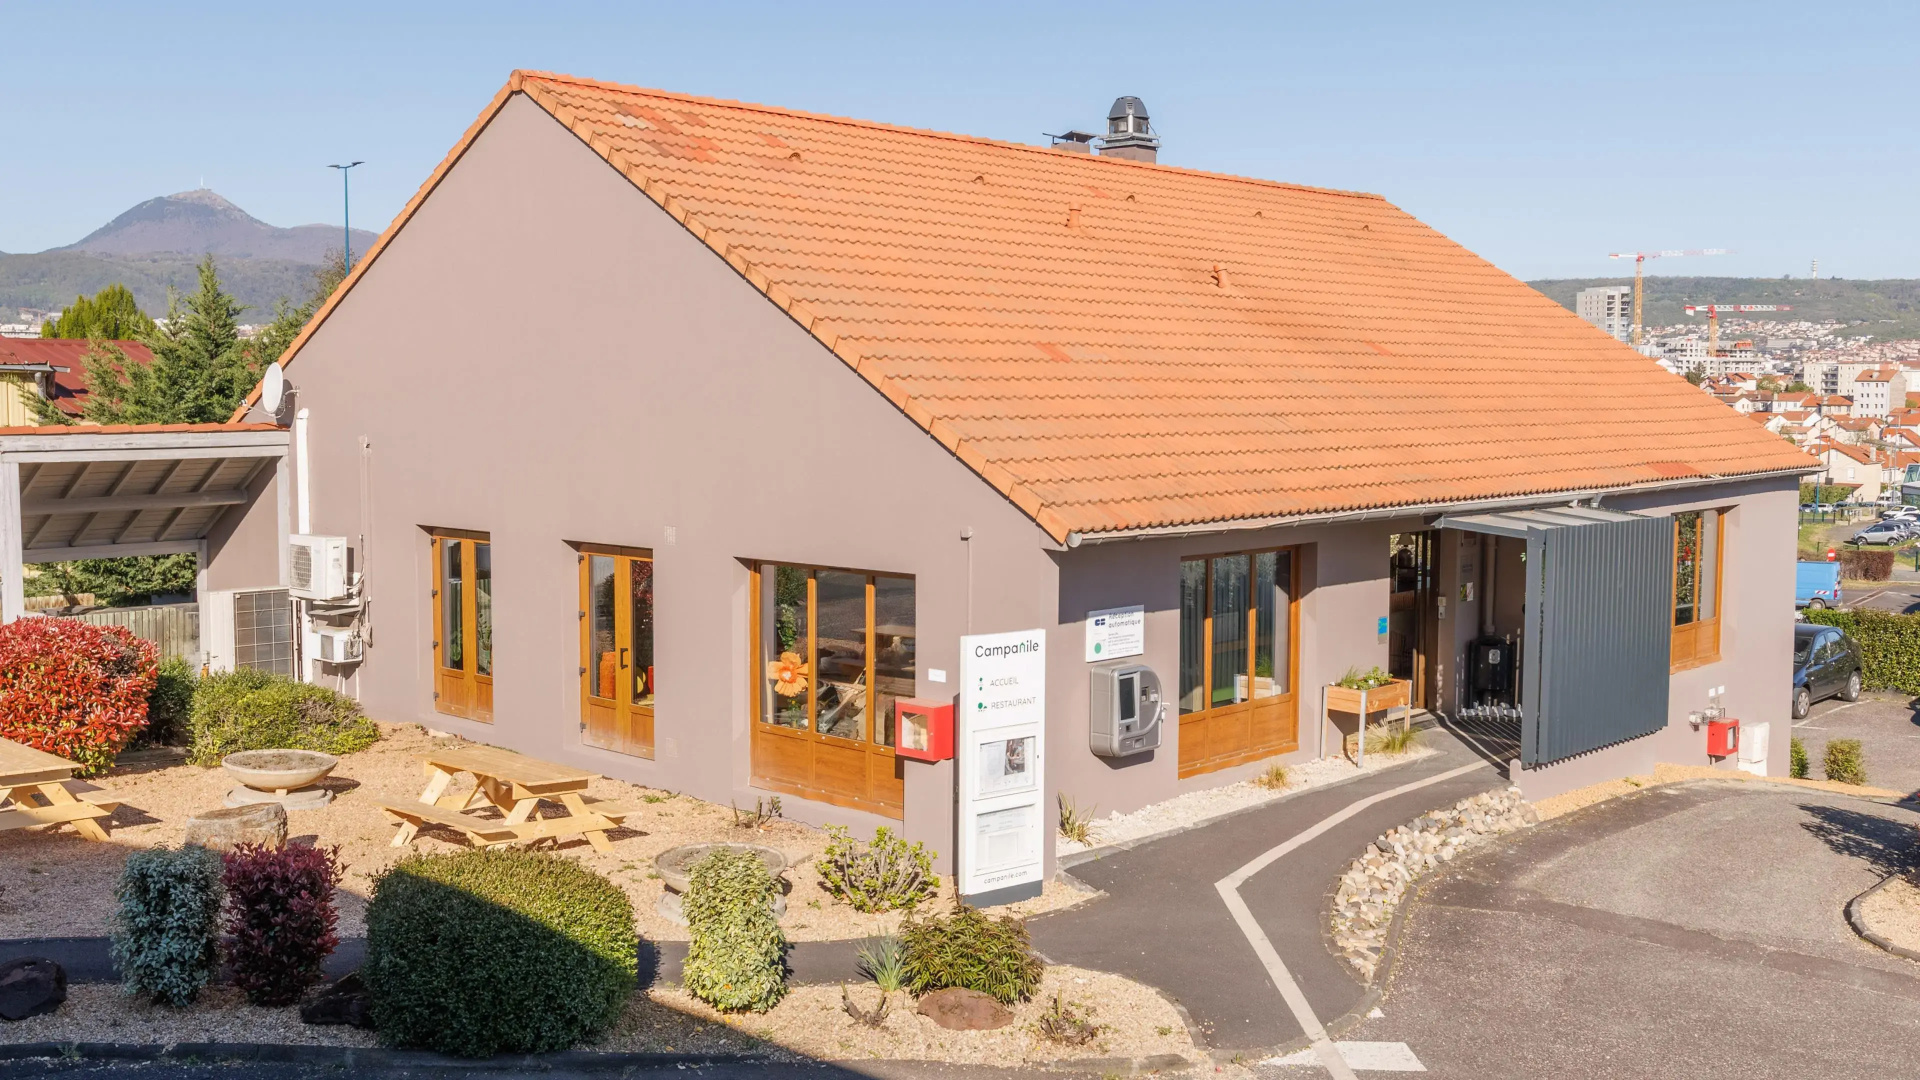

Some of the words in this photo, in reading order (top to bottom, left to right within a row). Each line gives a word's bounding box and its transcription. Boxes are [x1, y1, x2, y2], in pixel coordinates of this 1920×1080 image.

[1109, 619, 1141, 628] automatique
[975, 639, 1039, 659] Campanile
[990, 677, 1019, 687] ACCUEIL
[991, 697, 1036, 710] RESTAURANT
[983, 870, 1028, 884] campanile.com
